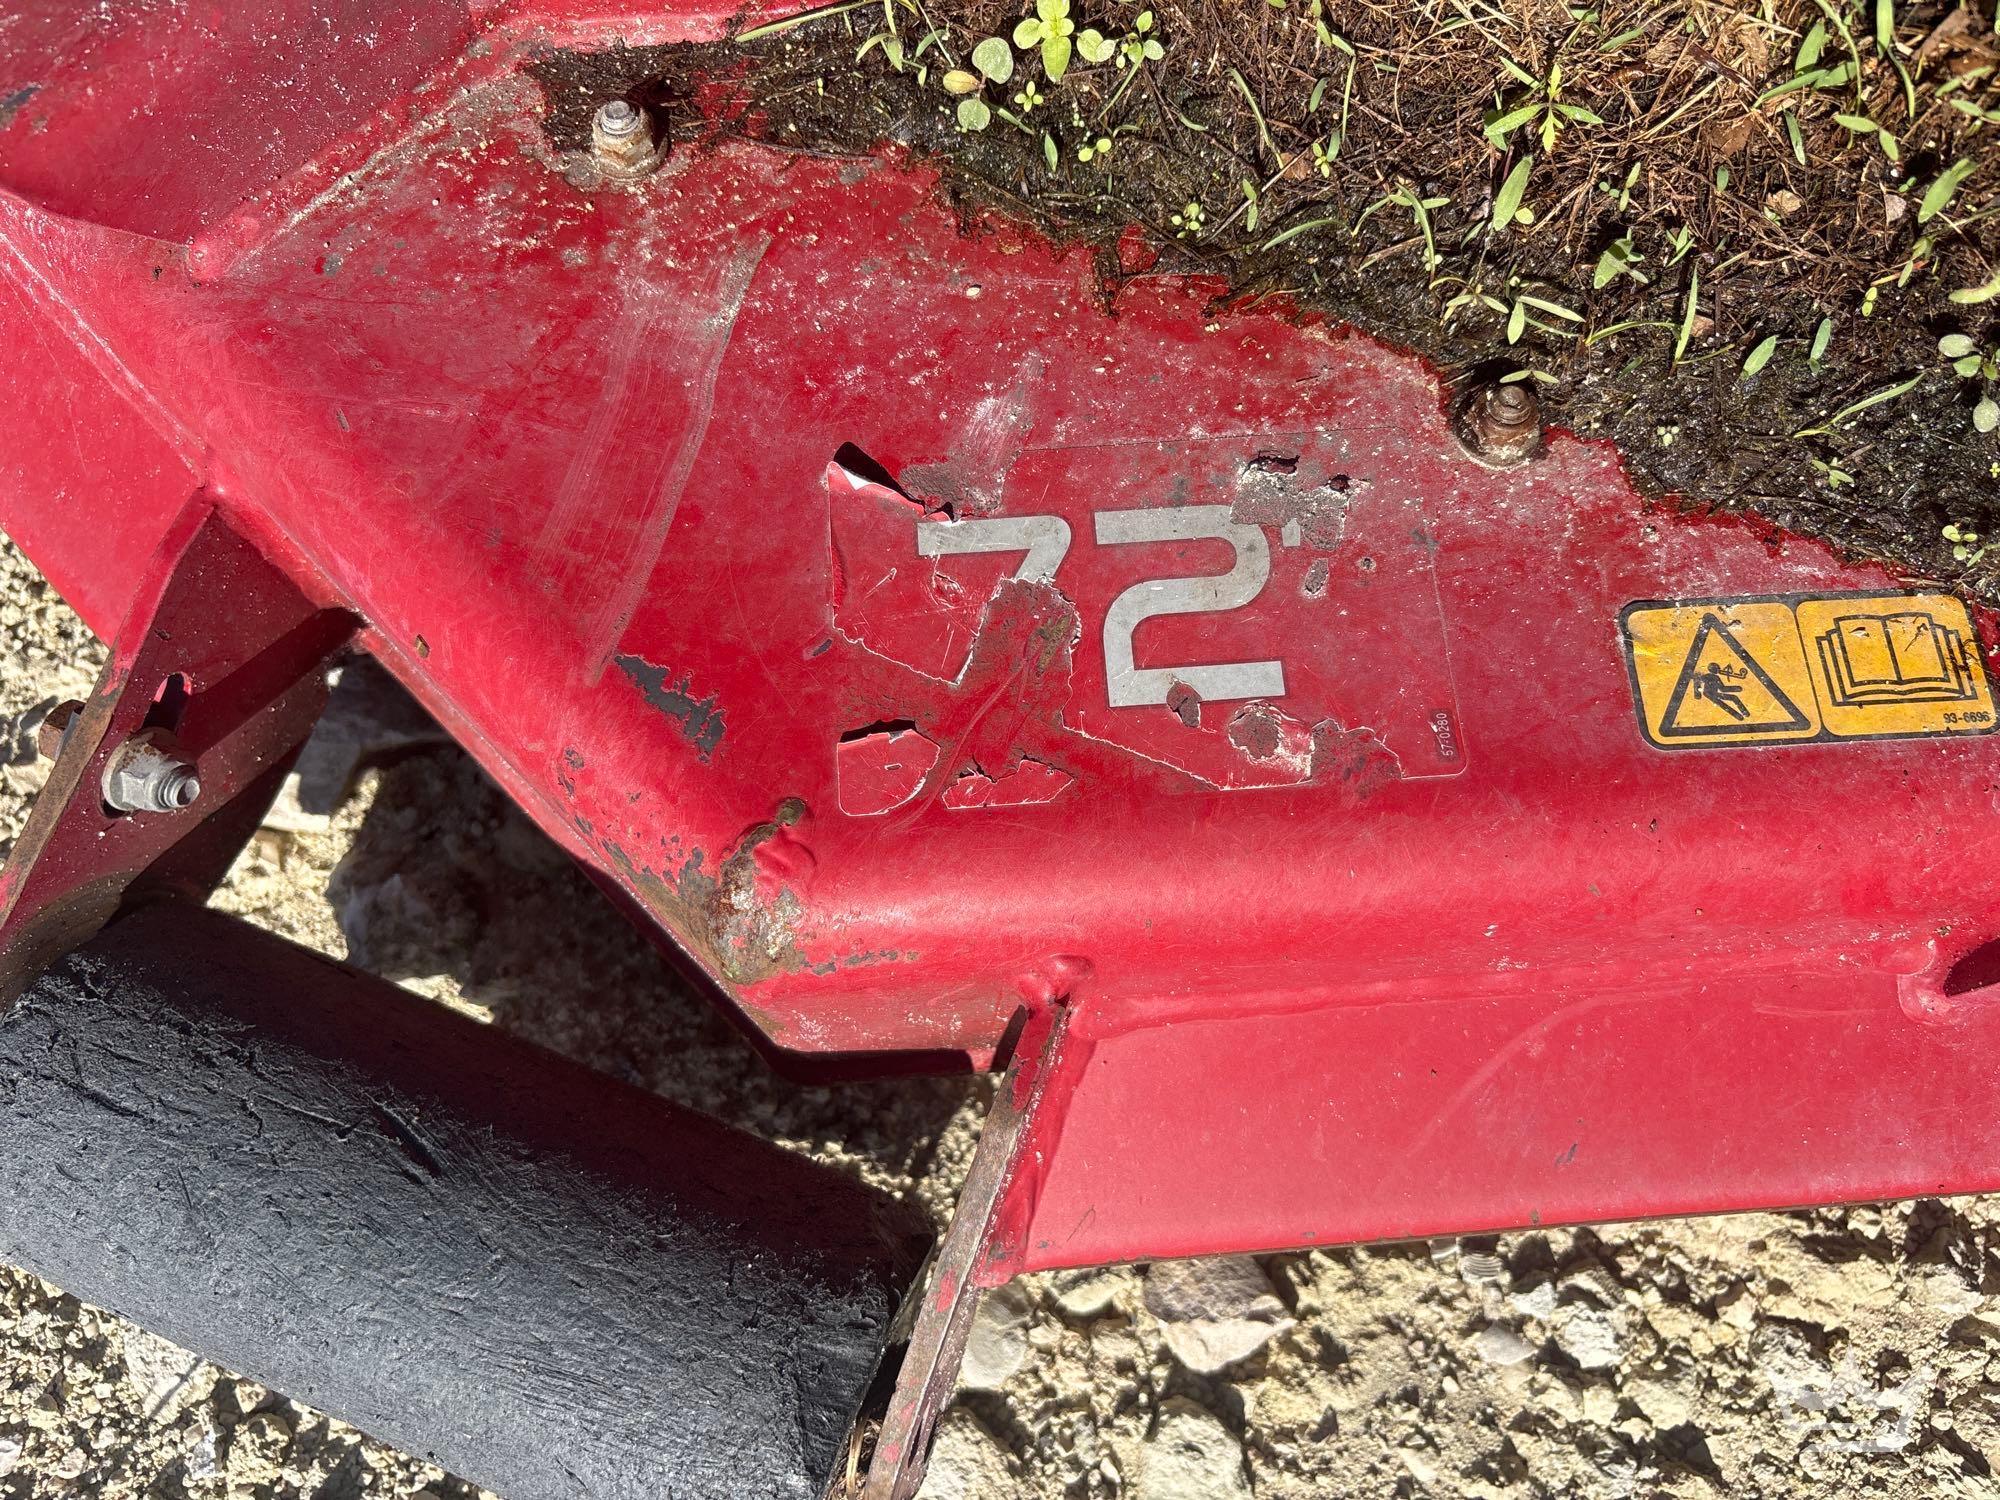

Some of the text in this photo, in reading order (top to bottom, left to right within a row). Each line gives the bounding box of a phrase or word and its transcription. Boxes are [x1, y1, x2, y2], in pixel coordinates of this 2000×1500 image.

[917, 505, 1301, 707] 72
[1436, 712, 1454, 756] 57-0280
[1943, 711, 1990, 723] 93-6696
